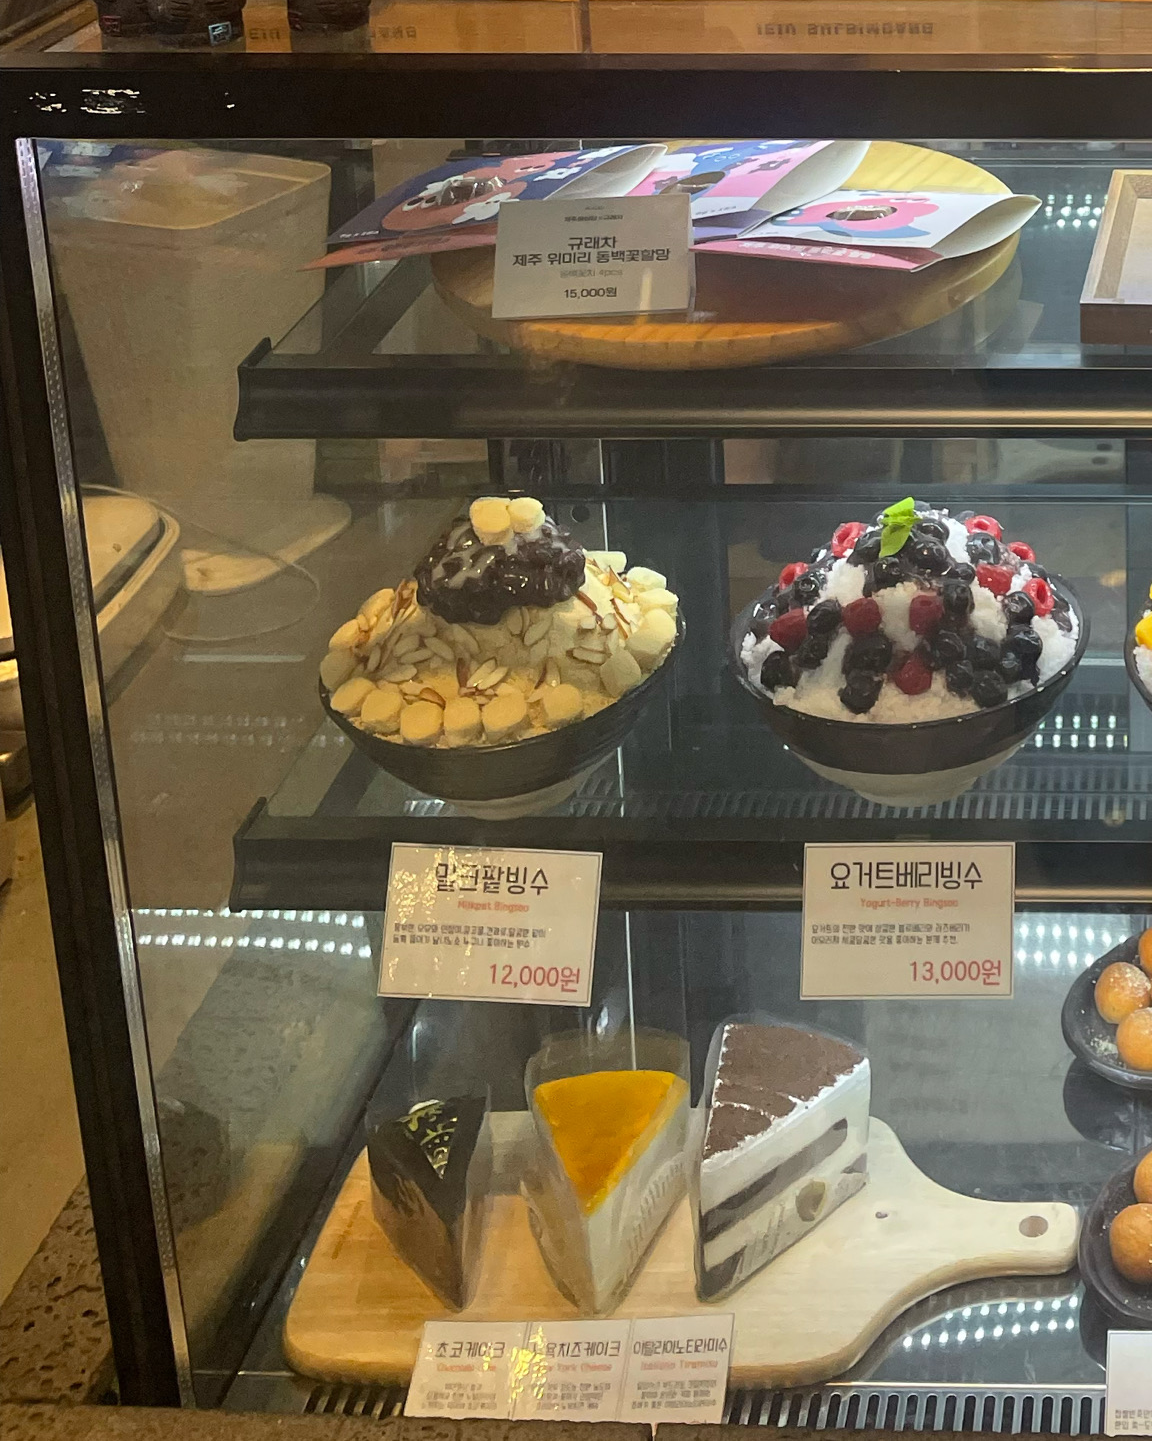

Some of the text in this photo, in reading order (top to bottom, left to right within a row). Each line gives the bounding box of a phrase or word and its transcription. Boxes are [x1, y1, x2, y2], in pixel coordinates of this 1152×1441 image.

[568, 236, 617, 250] 규래차
[513, 248, 670, 267] 제주 위미리 동백꽃할망
[564, 287, 617, 299] 15,000원
[831, 861, 983, 890] 요거트베리빙수
[489, 964, 581, 992] 12,000원
[910, 960, 1001, 986] 13,000원
[436, 1341, 505, 1358] 초코케이크
